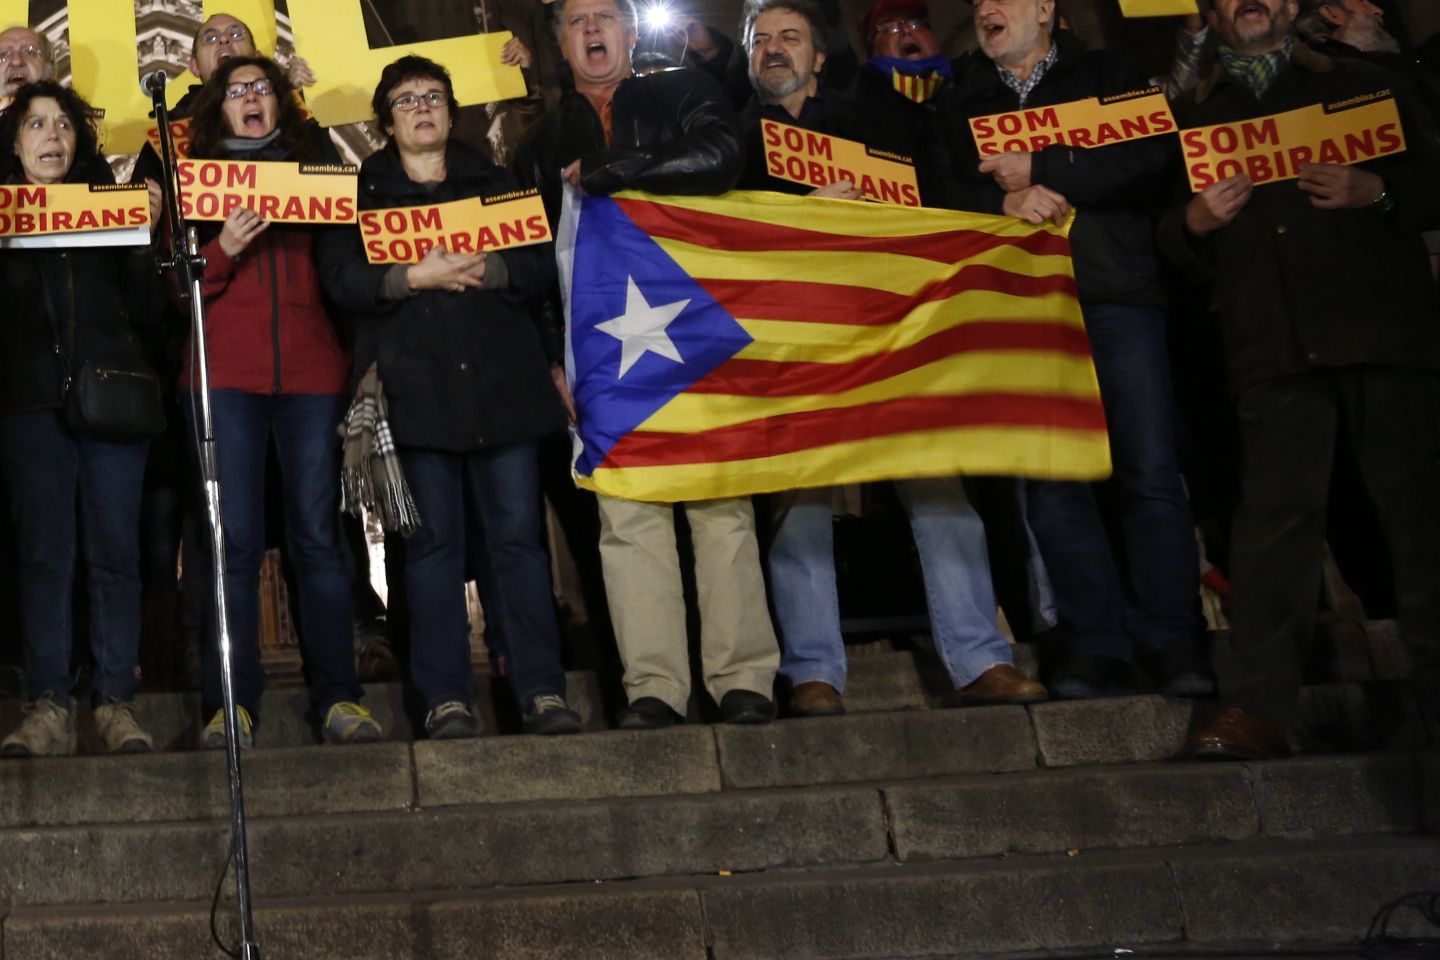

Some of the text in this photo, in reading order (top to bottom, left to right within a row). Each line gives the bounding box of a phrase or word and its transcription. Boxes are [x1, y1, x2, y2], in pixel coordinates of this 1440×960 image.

[1102, 86, 1160, 103] assemblea.cat
[972, 107, 1060, 139] SOM
[764, 122, 833, 161] SOM
[1183, 118, 1280, 158] SOM
[302, 164, 357, 174] assemblea.cat
[869, 147, 913, 164] assemblea.cat
[1190, 123, 1402, 190] SOBIRANS
[93, 183, 147, 191] assemblea.cat
[178, 162, 257, 189] SOM
[177, 192, 354, 221] SOBIRANS
[485, 187, 539, 204] assemblea.cat
[361, 208, 443, 236] SOM
[367, 215, 548, 262] SOBIRANS
